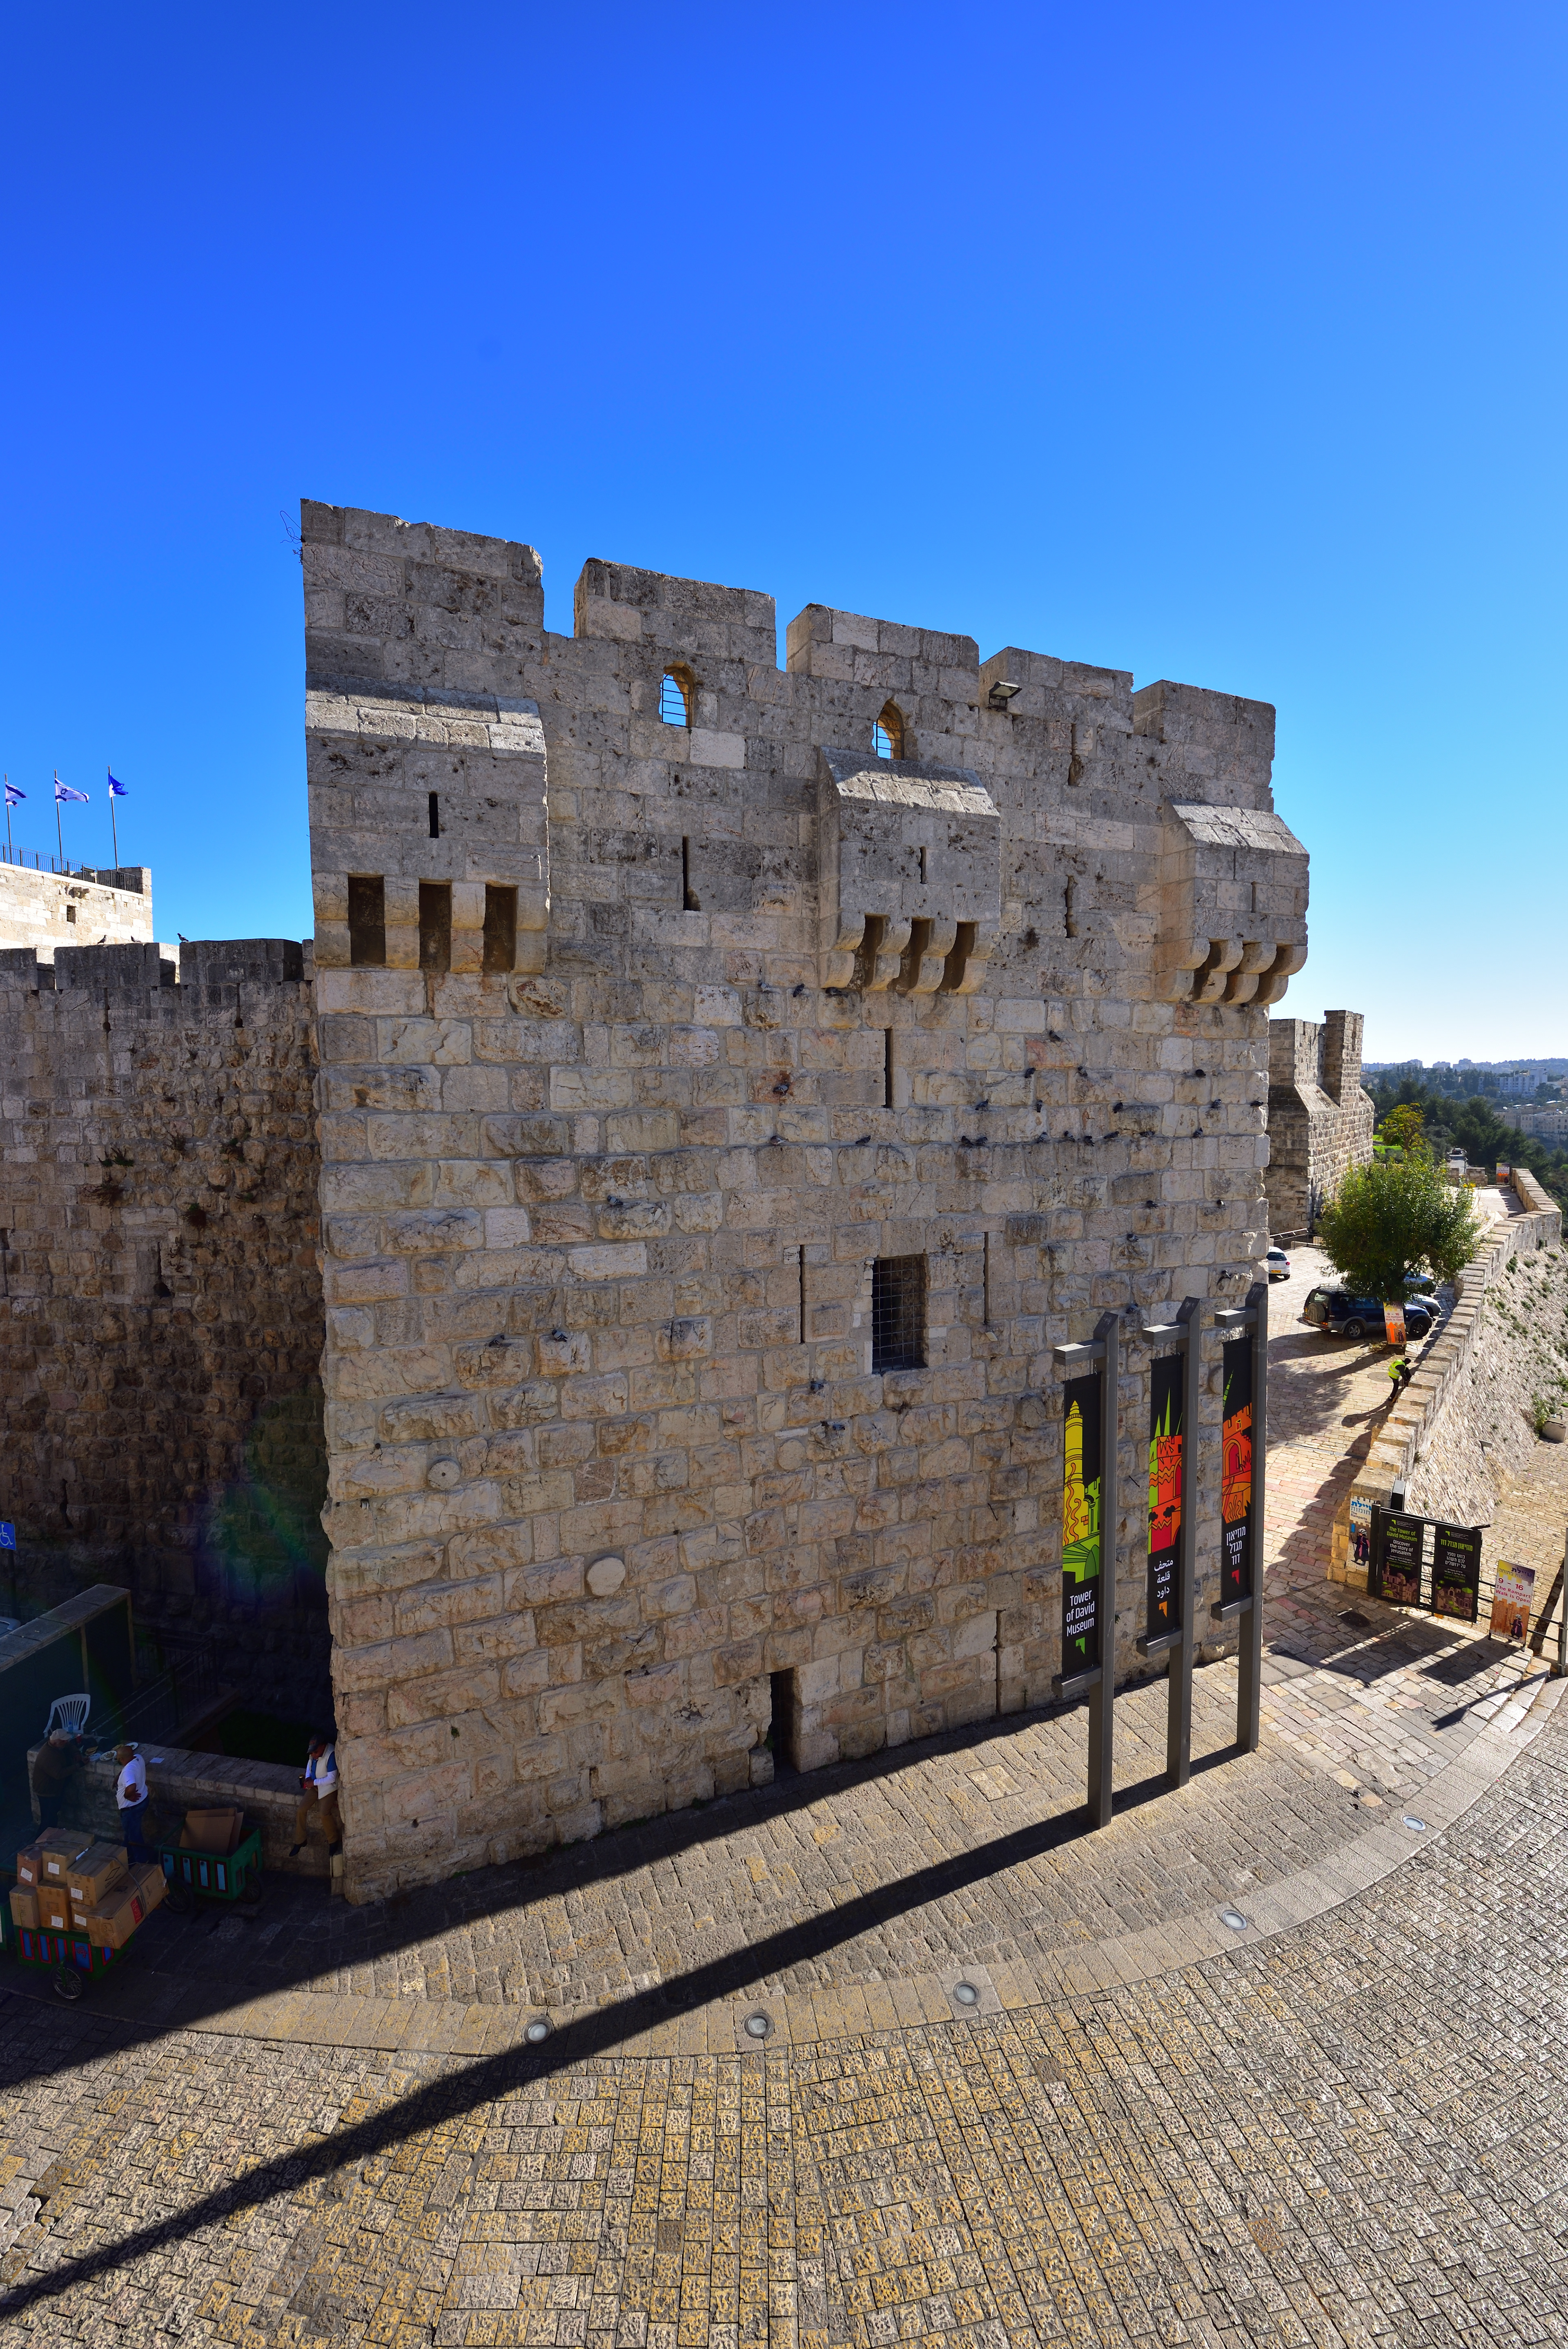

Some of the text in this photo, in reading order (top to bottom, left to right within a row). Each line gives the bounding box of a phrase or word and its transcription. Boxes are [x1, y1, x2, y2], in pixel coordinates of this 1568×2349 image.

[1226, 1526, 1246, 1546] מוזיאון
[1399, 1533, 1417, 1542] Museum
[1229, 1540, 1242, 1553] מגדל
[1391, 1548, 1412, 1556] Jerusalem
[1458, 1542, 1473, 1551] מוזיאון
[1154, 1559, 1173, 1571] متحف
[1232, 1553, 1240, 1565] דוד
[1157, 1571, 1170, 1583] قلعة
[1511, 1567, 1532, 1577] טיילת
[1157, 1586, 1170, 1598] داود
[1508, 1588, 1531, 1599] Rampart
[1070, 1590, 1092, 1607] Tower
[1066, 1601, 1095, 1622] of David
[1067, 1617, 1094, 1637] Museum
